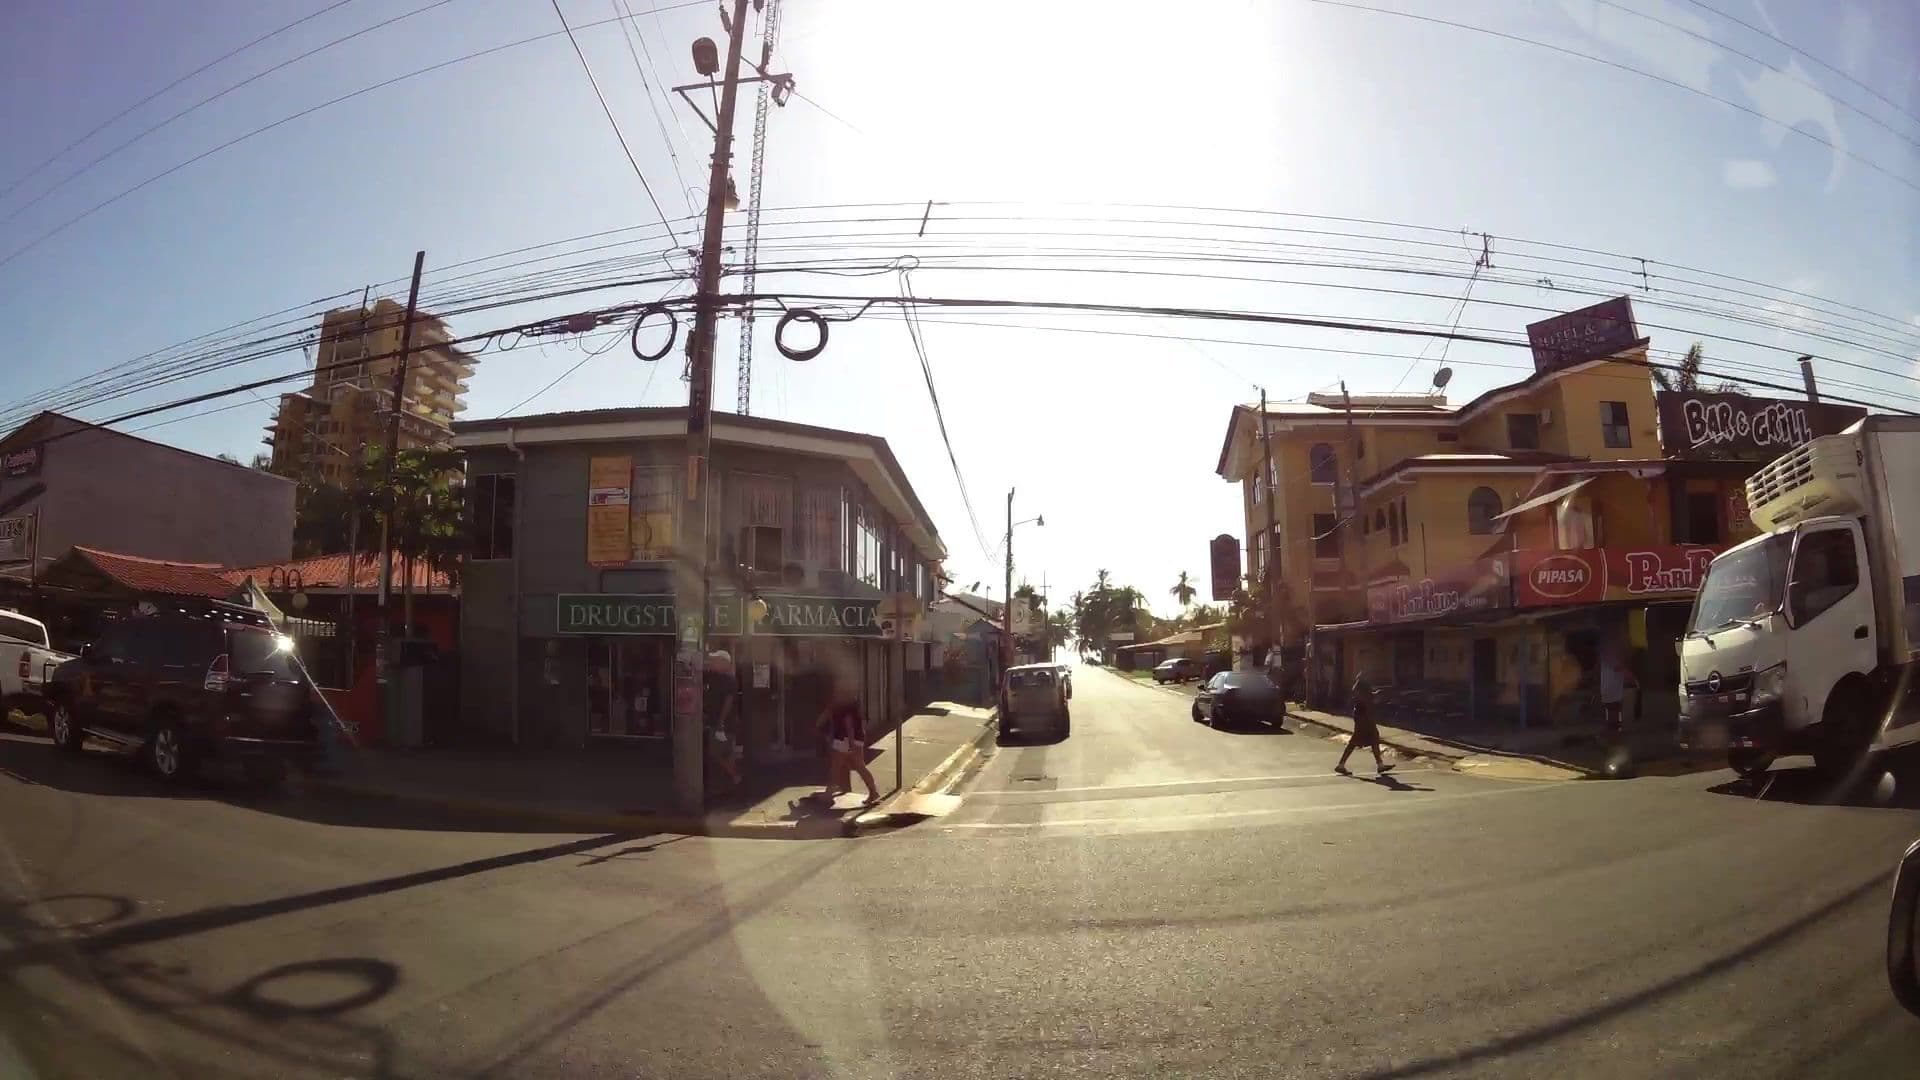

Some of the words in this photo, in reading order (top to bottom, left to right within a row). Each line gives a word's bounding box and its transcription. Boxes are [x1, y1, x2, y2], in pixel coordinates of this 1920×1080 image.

[1683, 399, 1735, 444] BAR
[1736, 410, 1750, 436] &
[1537, 568, 1584, 585] PIPASA
[569, 603, 729, 628] DRUGSTE
